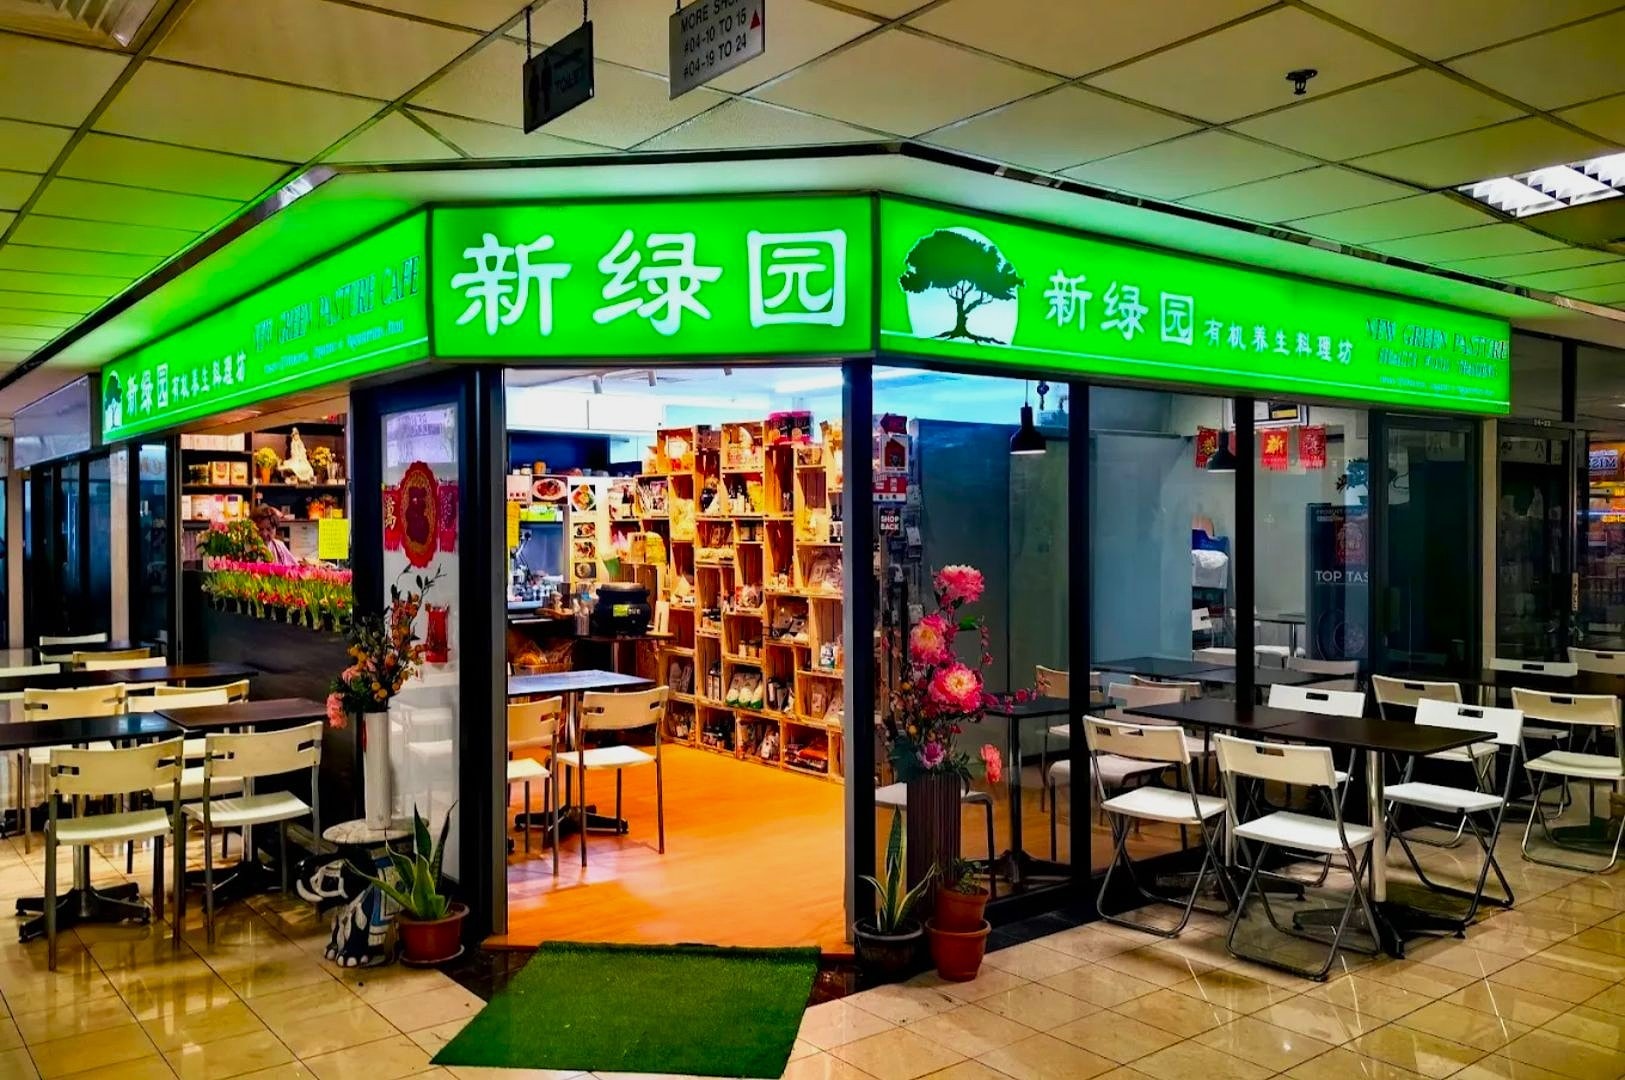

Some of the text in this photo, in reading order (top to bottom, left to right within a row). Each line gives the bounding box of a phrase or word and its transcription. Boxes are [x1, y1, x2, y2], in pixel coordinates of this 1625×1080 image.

[681, 4, 709, 33] MORE
[684, 7, 747, 59] #04-10 TO 15
[684, 33, 747, 80] #04-19 TO 24
[381, 255, 420, 306] CAFE
[450, 229, 848, 337] 新绿园
[1043, 269, 1354, 365] 新绿园 有机养生料理坊
[126, 362, 169, 417] 新绿园
[1315, 570, 1343, 583] TOP
